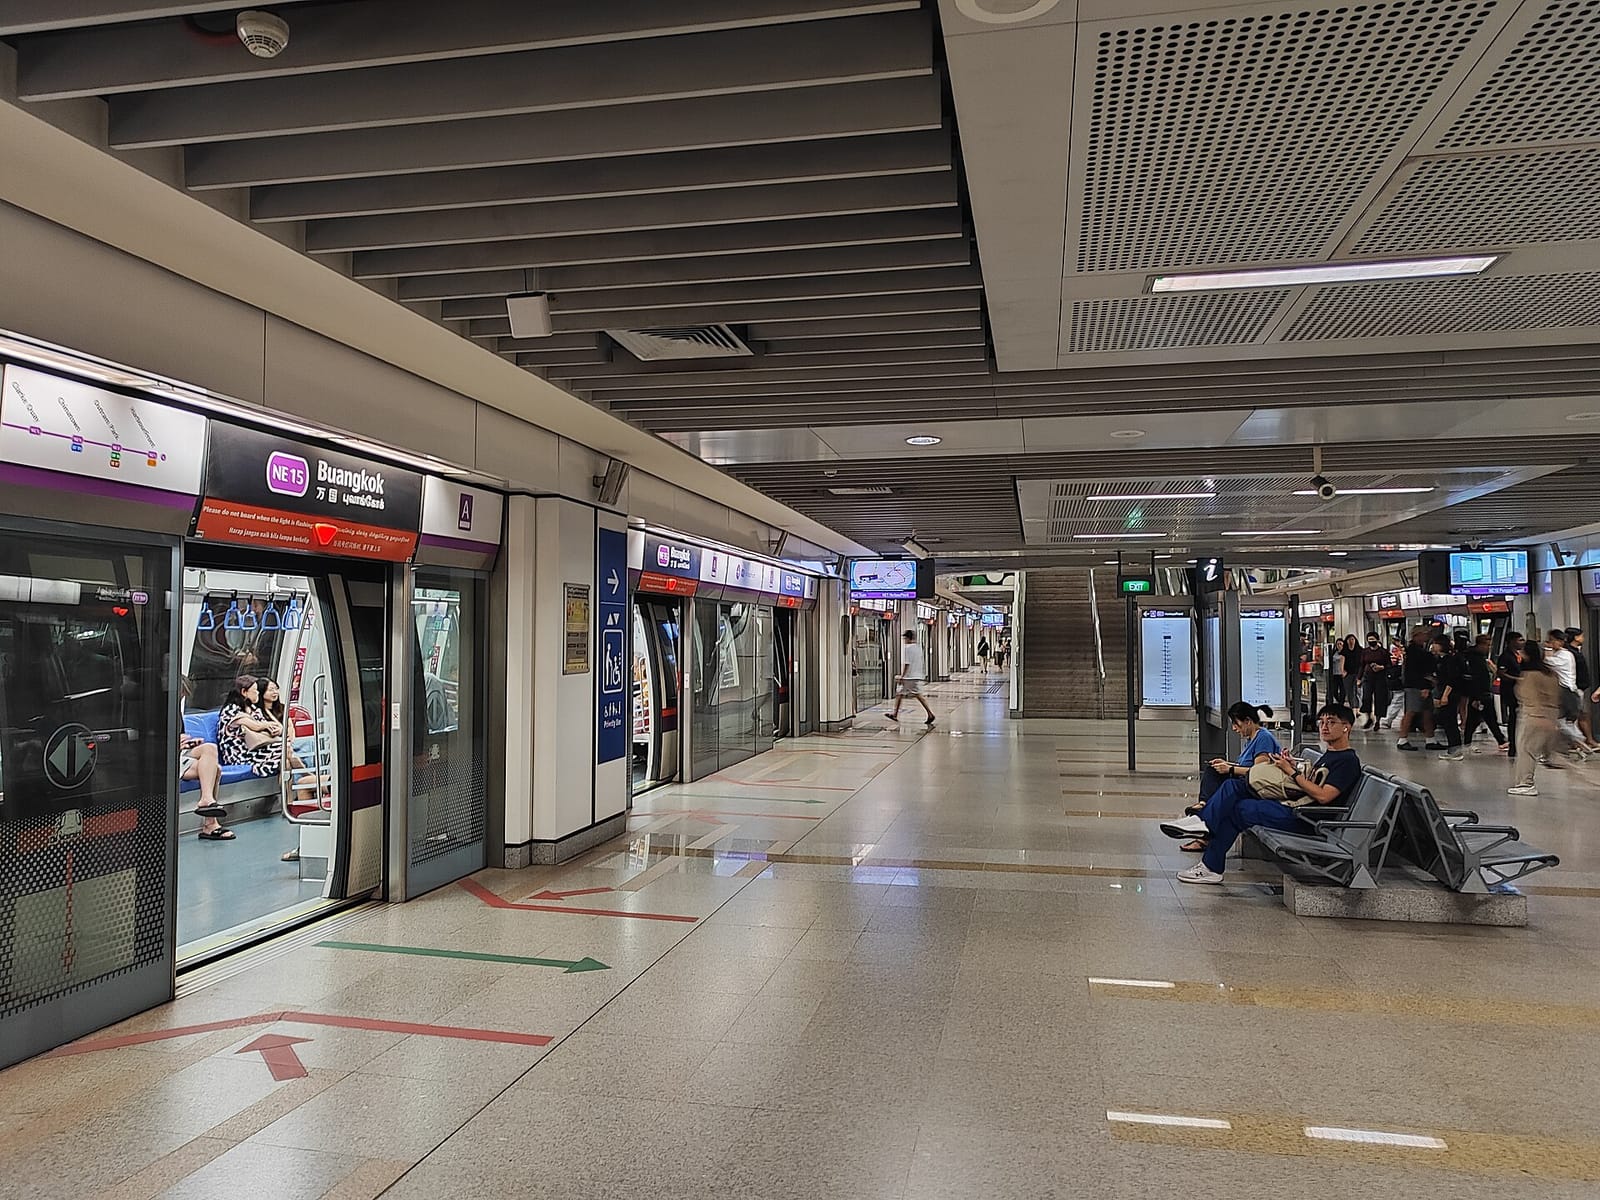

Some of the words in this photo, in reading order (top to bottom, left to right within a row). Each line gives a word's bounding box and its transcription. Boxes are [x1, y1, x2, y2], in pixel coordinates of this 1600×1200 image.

[272, 463, 289, 482] NE
[289, 468, 304, 485] 15
[317, 460, 385, 495] Buangkok
[203, 505, 221, 514] Please
[221, 508, 230, 516] do
[240, 511, 257, 520] board
[257, 514, 271, 522] when
[270, 516, 279, 524] the
[279, 517, 291, 526] light
[295, 519, 314, 529] flashing
[461, 500, 470, 520] A
[229, 527, 244, 535] Harap
[244, 528, 260, 538] jangan
[1129, 583, 1143, 591] EXIT
